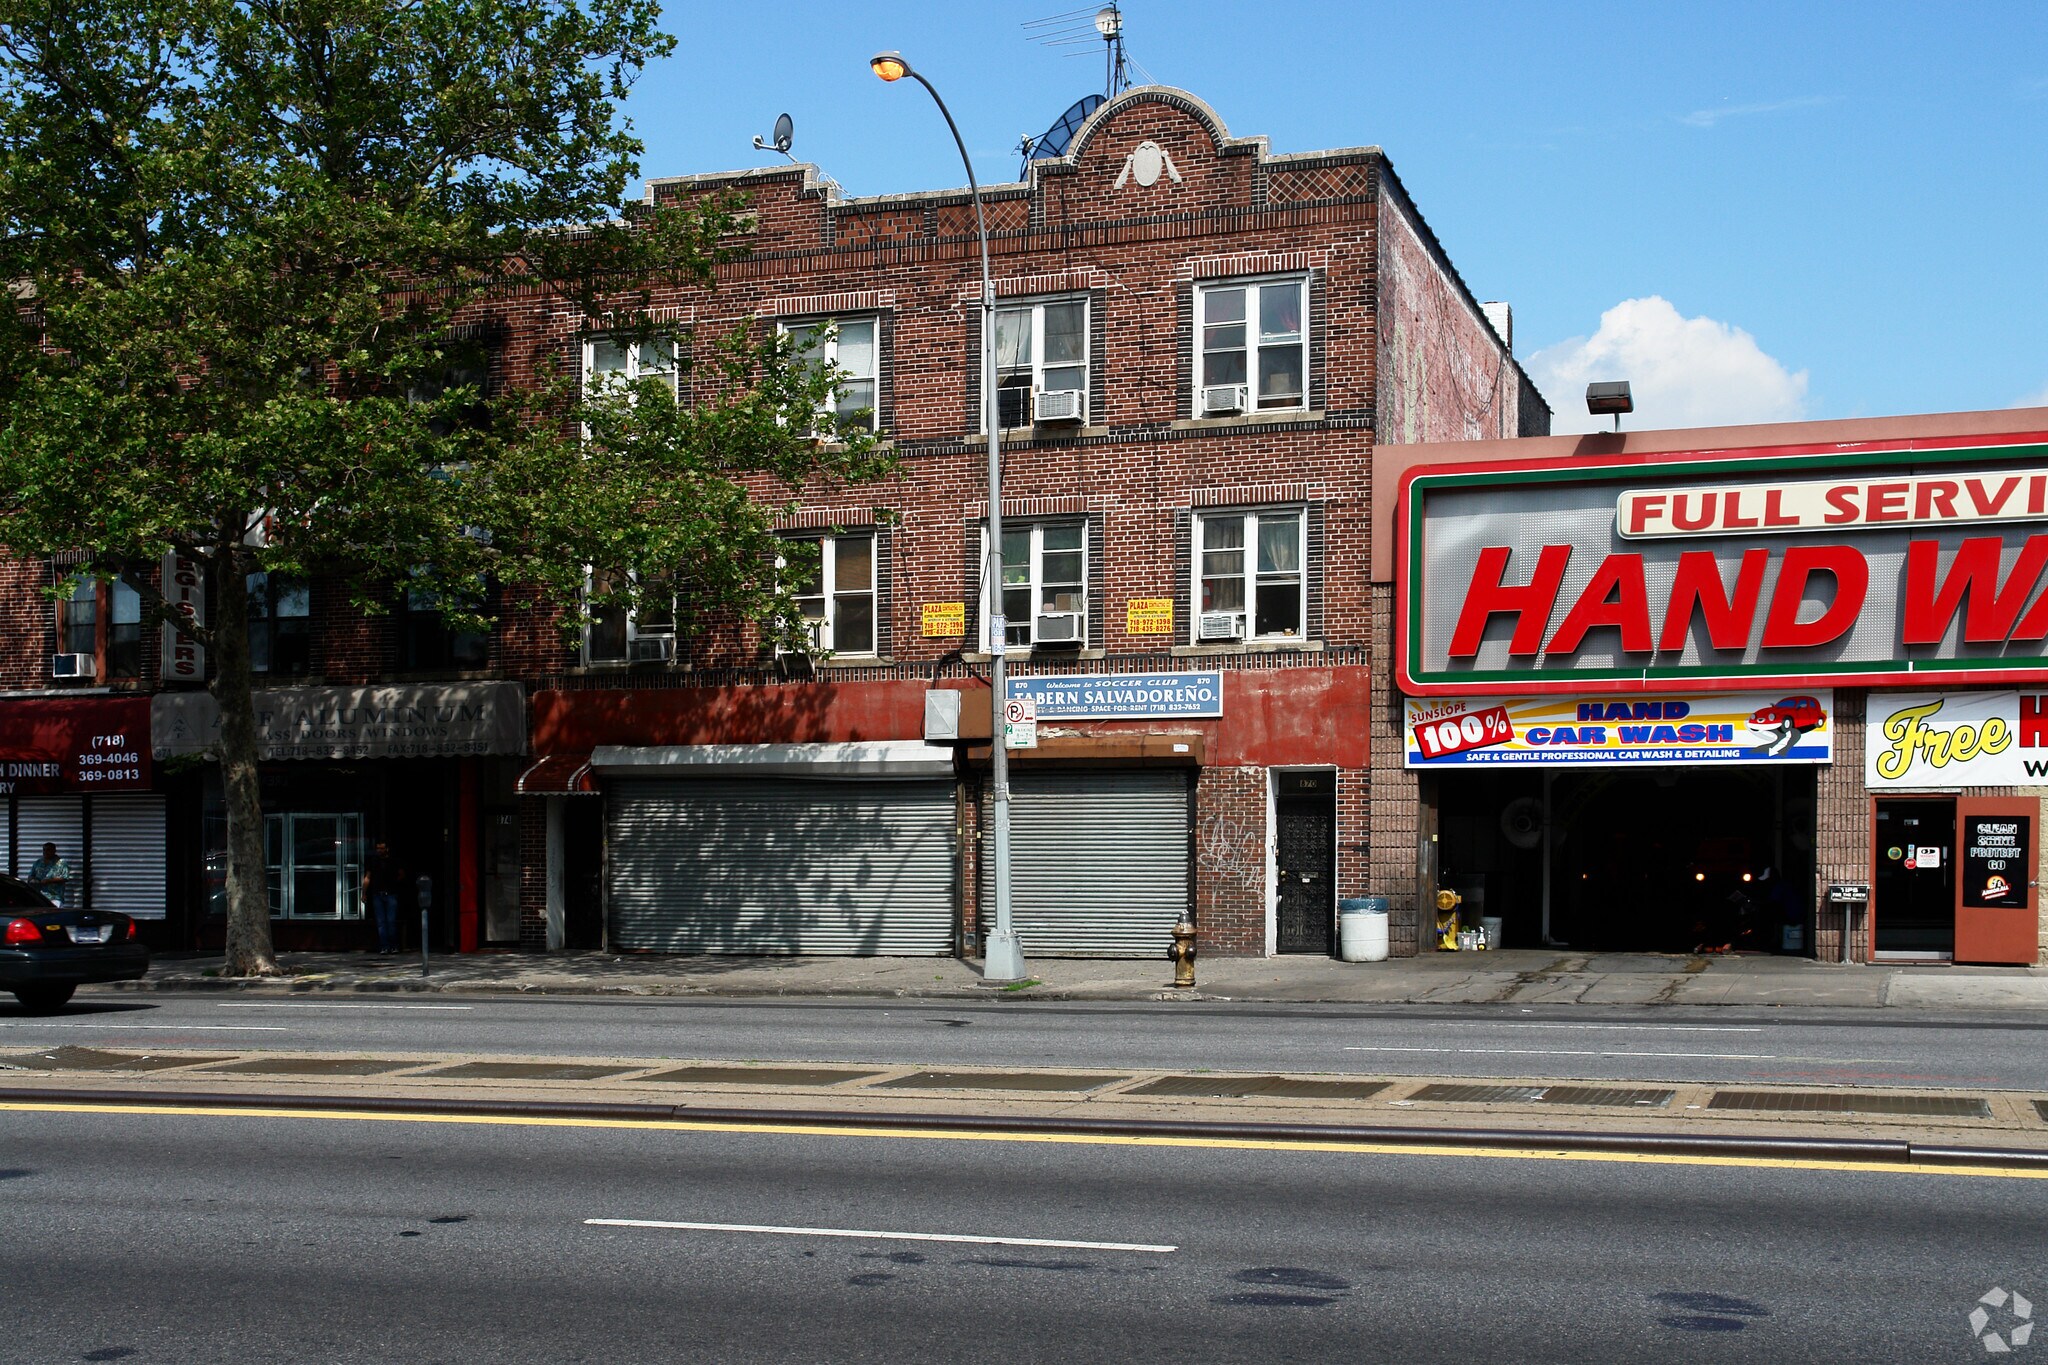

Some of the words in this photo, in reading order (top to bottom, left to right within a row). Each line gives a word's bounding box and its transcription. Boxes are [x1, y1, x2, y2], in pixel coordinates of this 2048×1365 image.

[1629, 489, 1801, 533] FULL
[1824, 475, 2048, 525] SERVI
[1130, 601, 1148, 610] PLAZA
[1448, 543, 1870, 657] HAND
[924, 605, 942, 613] PLAZA
[1085, 684, 1212, 704] SALVADOREÑO
[1150, 704, 1166, 712] (718)
[1169, 703, 1201, 711] 832-7652
[1411, 702, 1466, 723] SUNSLOPE
[1576, 701, 1691, 722] HAND
[295, 704, 484, 726] ALUMINUM
[254, 729, 291, 741] LASS
[301, 728, 357, 739] DOORS
[367, 727, 448, 738] WINDOWS
[1423, 710, 1507, 754] 100%
[1525, 726, 1607, 746] CAR
[1616, 724, 1734, 744] WASH
[1876, 698, 2013, 780] Free
[92, 735, 124, 749] (718)
[79, 752, 138, 765] 369-4046
[1466, 753, 1491, 761] SAFE
[1501, 752, 1539, 760] GENTLE
[1541, 751, 1616, 760] PROFESSIONAL
[1618, 751, 1640, 759] CAR
[1641, 750, 1673, 759] WASH
[1675, 750, 1682, 758] &
[1684, 749, 1740, 759] DETAILING
[9, 763, 60, 777] DINNER
[79, 769, 139, 781] 369-0813
[1977, 823, 2017, 834] CLEAN
[1977, 835, 2015, 846] SHINE
[1970, 847, 2022, 858] PROTECT
[1988, 860, 2006, 870] GO
